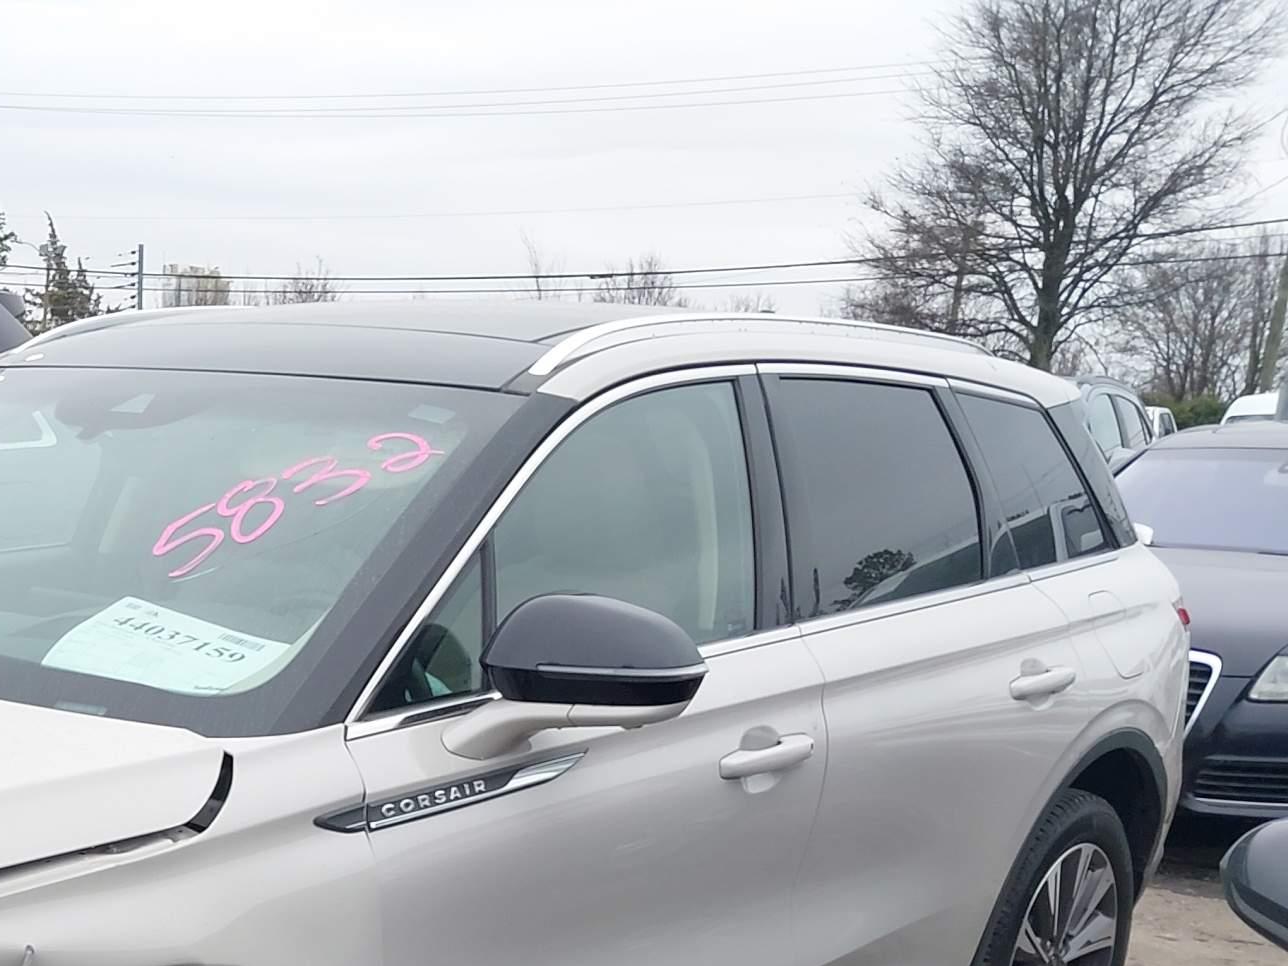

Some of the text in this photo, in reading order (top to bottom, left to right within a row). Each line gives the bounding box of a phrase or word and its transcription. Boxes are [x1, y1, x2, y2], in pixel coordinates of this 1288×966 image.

[152, 431, 446, 578] 5832
[113, 615, 247, 664] 44037159
[381, 779, 487, 818] CORSAIR
